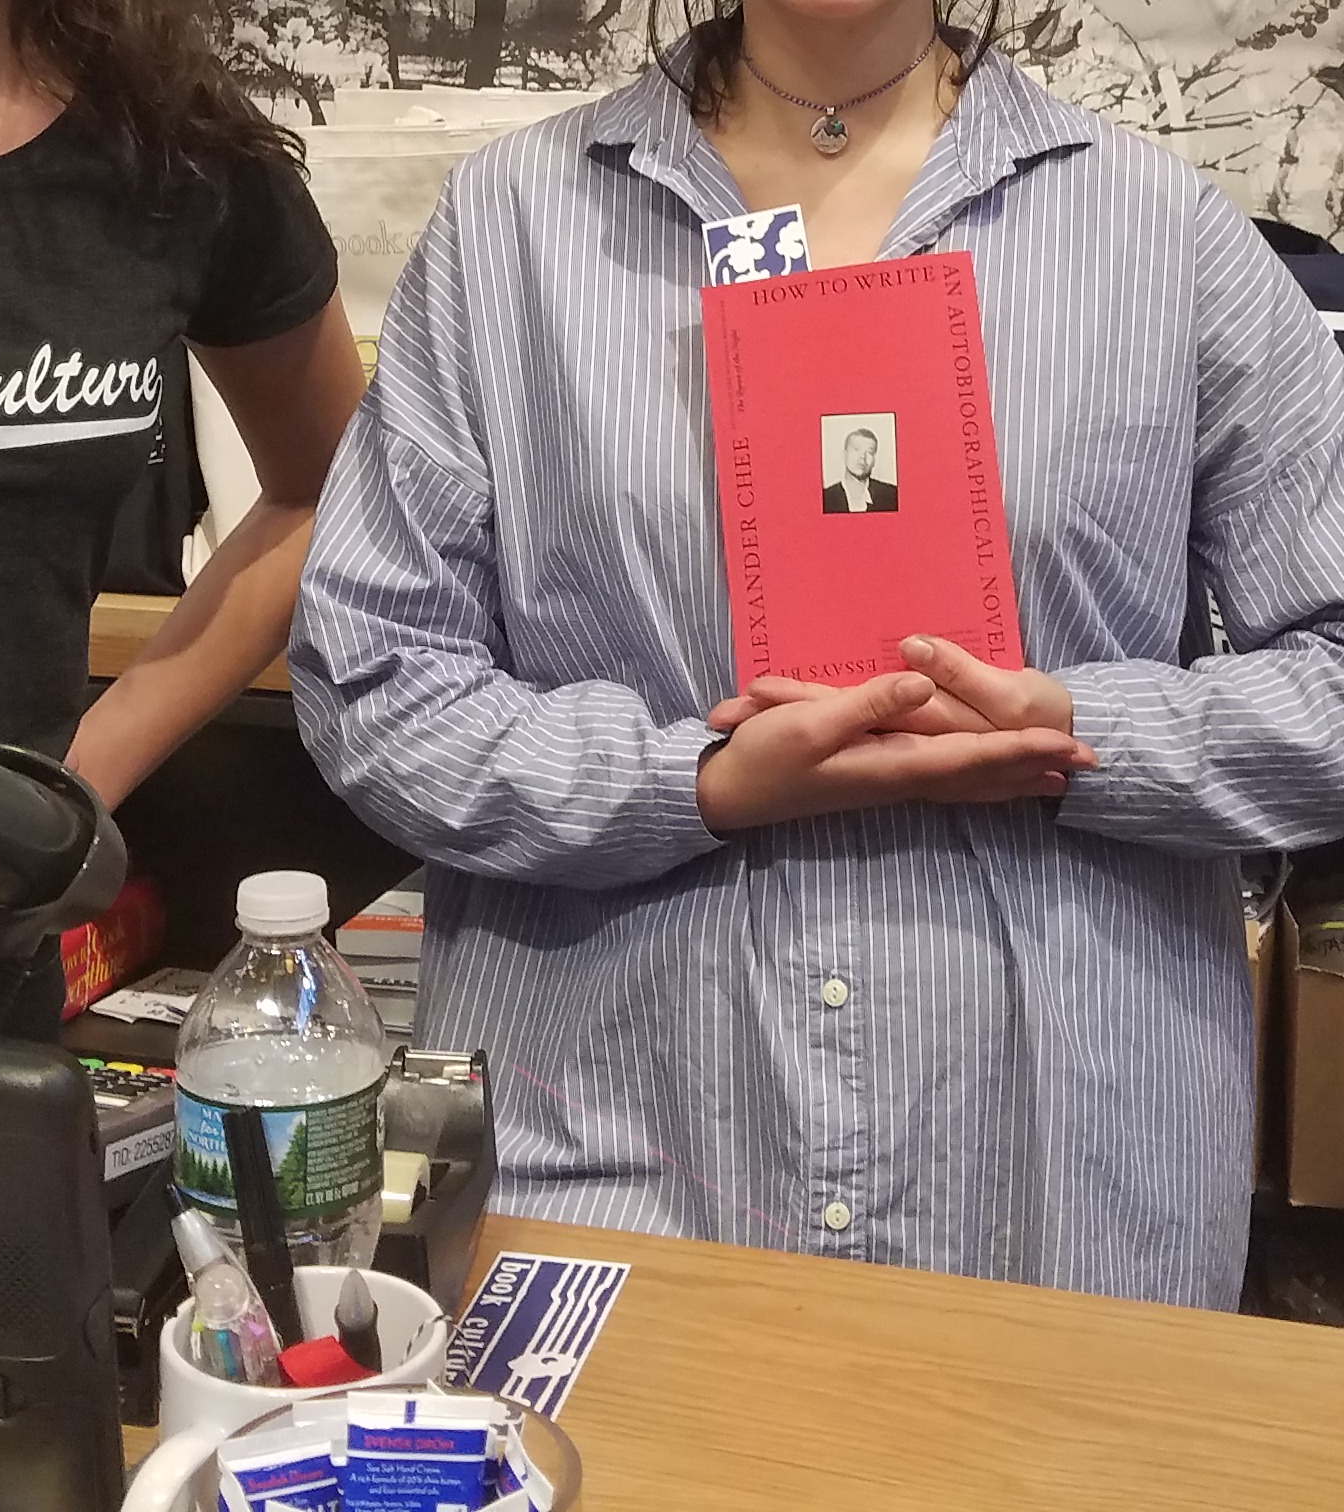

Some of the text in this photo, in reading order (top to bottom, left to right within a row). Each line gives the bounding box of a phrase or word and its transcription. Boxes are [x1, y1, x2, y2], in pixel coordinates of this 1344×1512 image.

[752, 264, 937, 308] HOW TO WRITE
[732, 436, 752, 508] CHEE
[942, 264, 1008, 663] AN AUTOBIOGRAPHICAL NOVEL
[741, 515, 771, 680] ALEXANDER
[809, 659, 876, 677] ESSAYS
[479, 1259, 531, 1308] book
